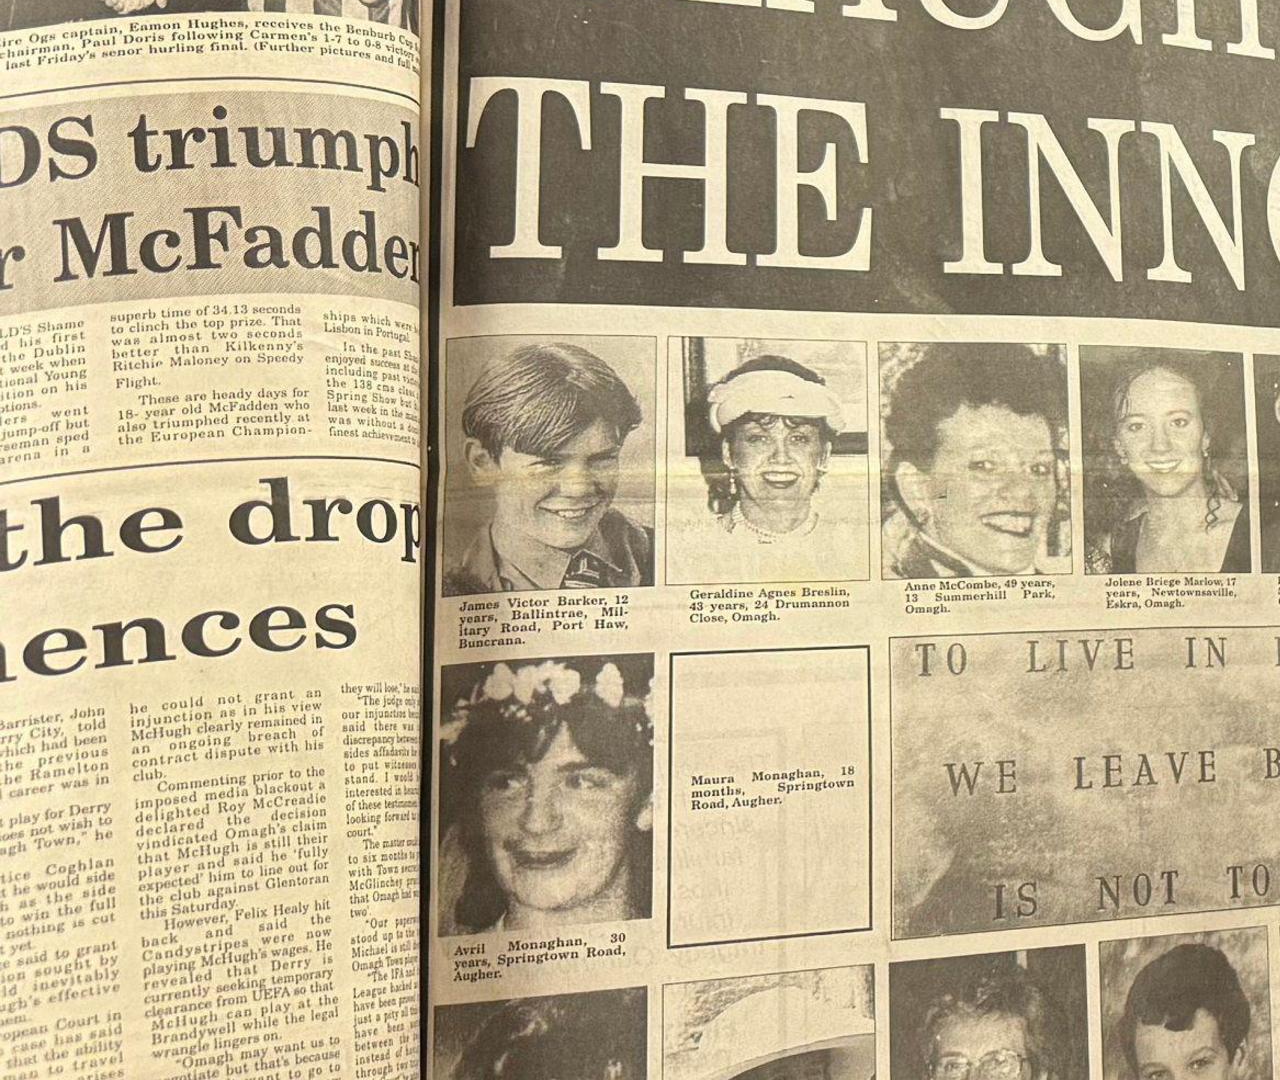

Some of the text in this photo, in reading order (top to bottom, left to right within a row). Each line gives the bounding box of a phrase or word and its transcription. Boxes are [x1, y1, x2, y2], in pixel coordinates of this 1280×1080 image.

[465, 75, 873, 275] THE
[110, 303, 301, 324] superb time of 34.13 seconds
[689, 586, 849, 600] Geraldine Agnes Breslin,
[459, 594, 628, 612] James Victor Barker, 12
[459, 606, 628, 624] years, Ballintrae, Mil-
[459, 620, 628, 637] itary Road, Port Haw,
[458, 637, 525, 649] Buncrana.
[916, 642, 968, 676] TO
[1026, 638, 1136, 672] LIVE
[1184, 636, 1228, 669] IN
[944, 760, 1017, 796] WE
[1073, 751, 1217, 790] LEAVE
[993, 883, 1038, 920] IS
[1098, 871, 1179, 911] NOT
[1226, 864, 1271, 899] TO
